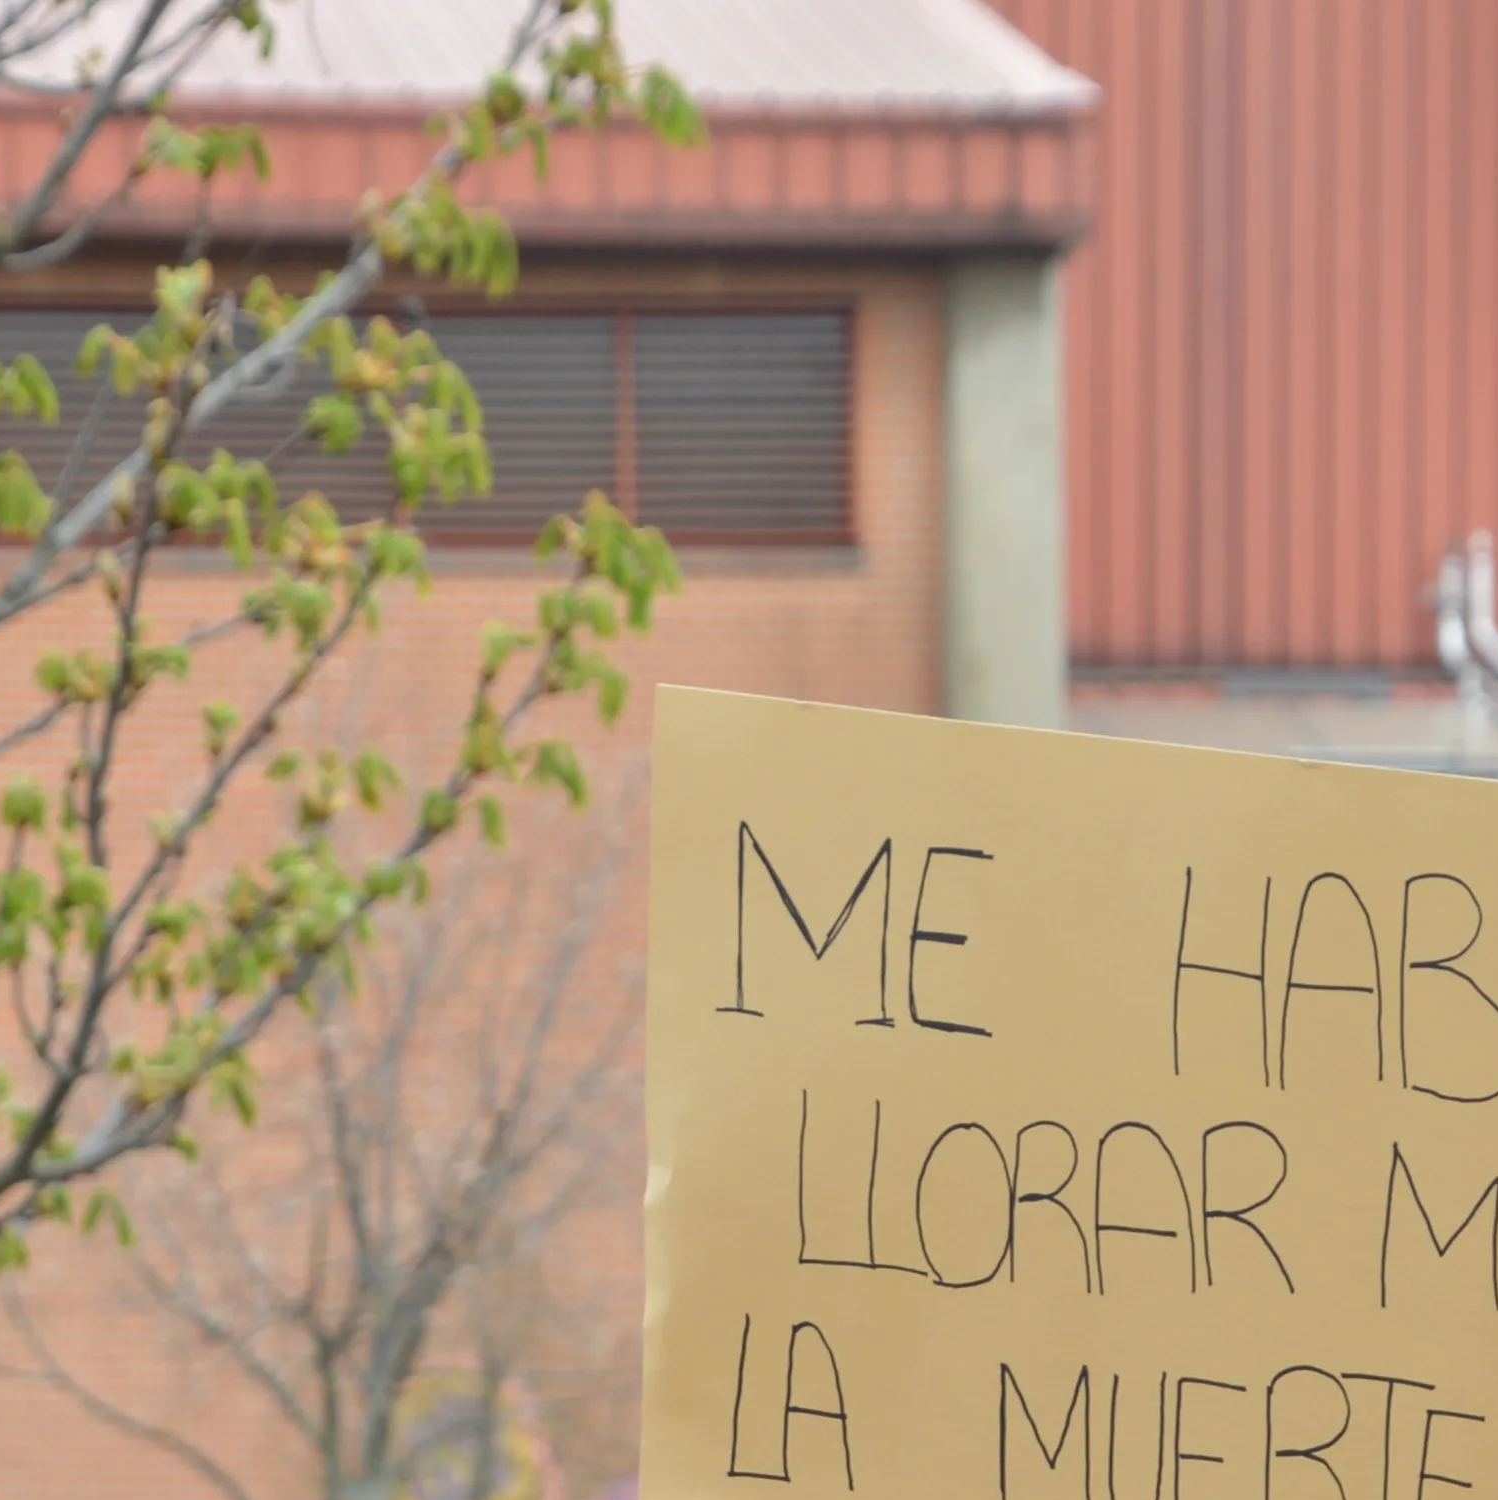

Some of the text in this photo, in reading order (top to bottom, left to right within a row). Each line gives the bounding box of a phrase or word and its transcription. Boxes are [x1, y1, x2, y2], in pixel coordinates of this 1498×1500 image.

[715, 819, 995, 1038] ME
[797, 1088, 1295, 1297] LLORAR
[725, 1312, 856, 1493] LA
